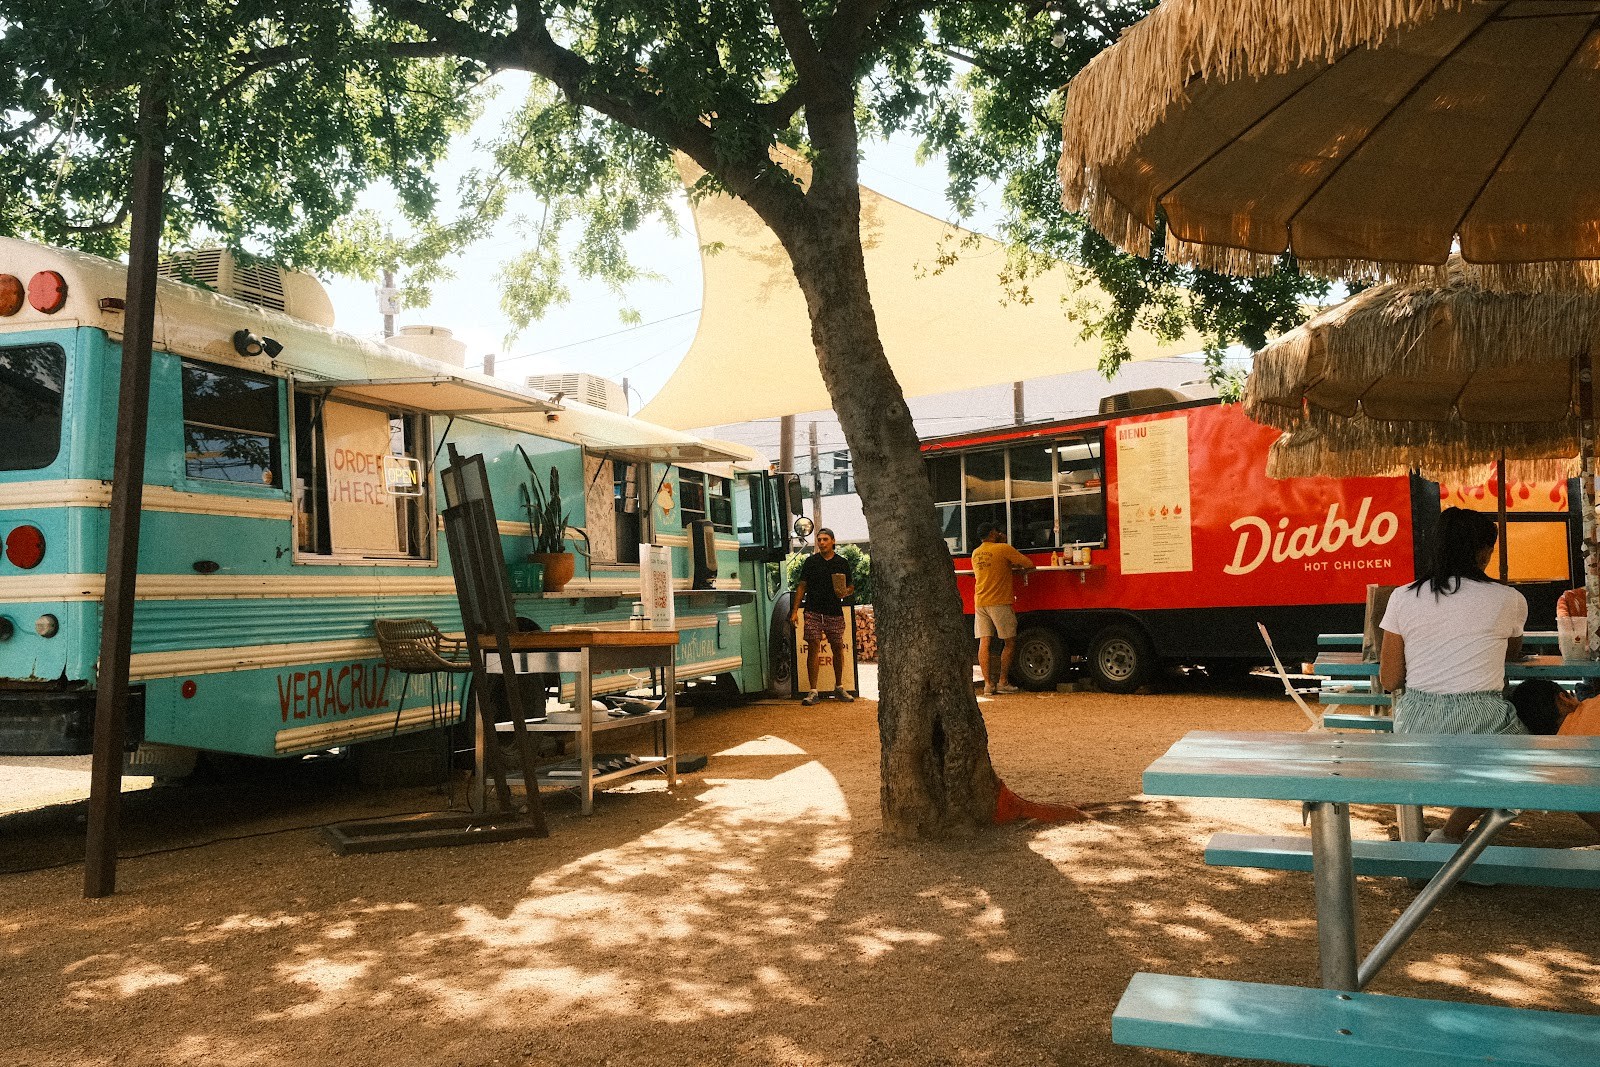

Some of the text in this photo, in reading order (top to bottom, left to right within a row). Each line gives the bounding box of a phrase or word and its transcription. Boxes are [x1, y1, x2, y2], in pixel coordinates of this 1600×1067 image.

[1119, 427, 1147, 441] MENU
[387, 467, 418, 485] OPEN
[1222, 496, 1399, 576] Diablo
[1304, 559, 1392, 571] HOT CHICKEN
[277, 663, 390, 722] VERACRUZ
